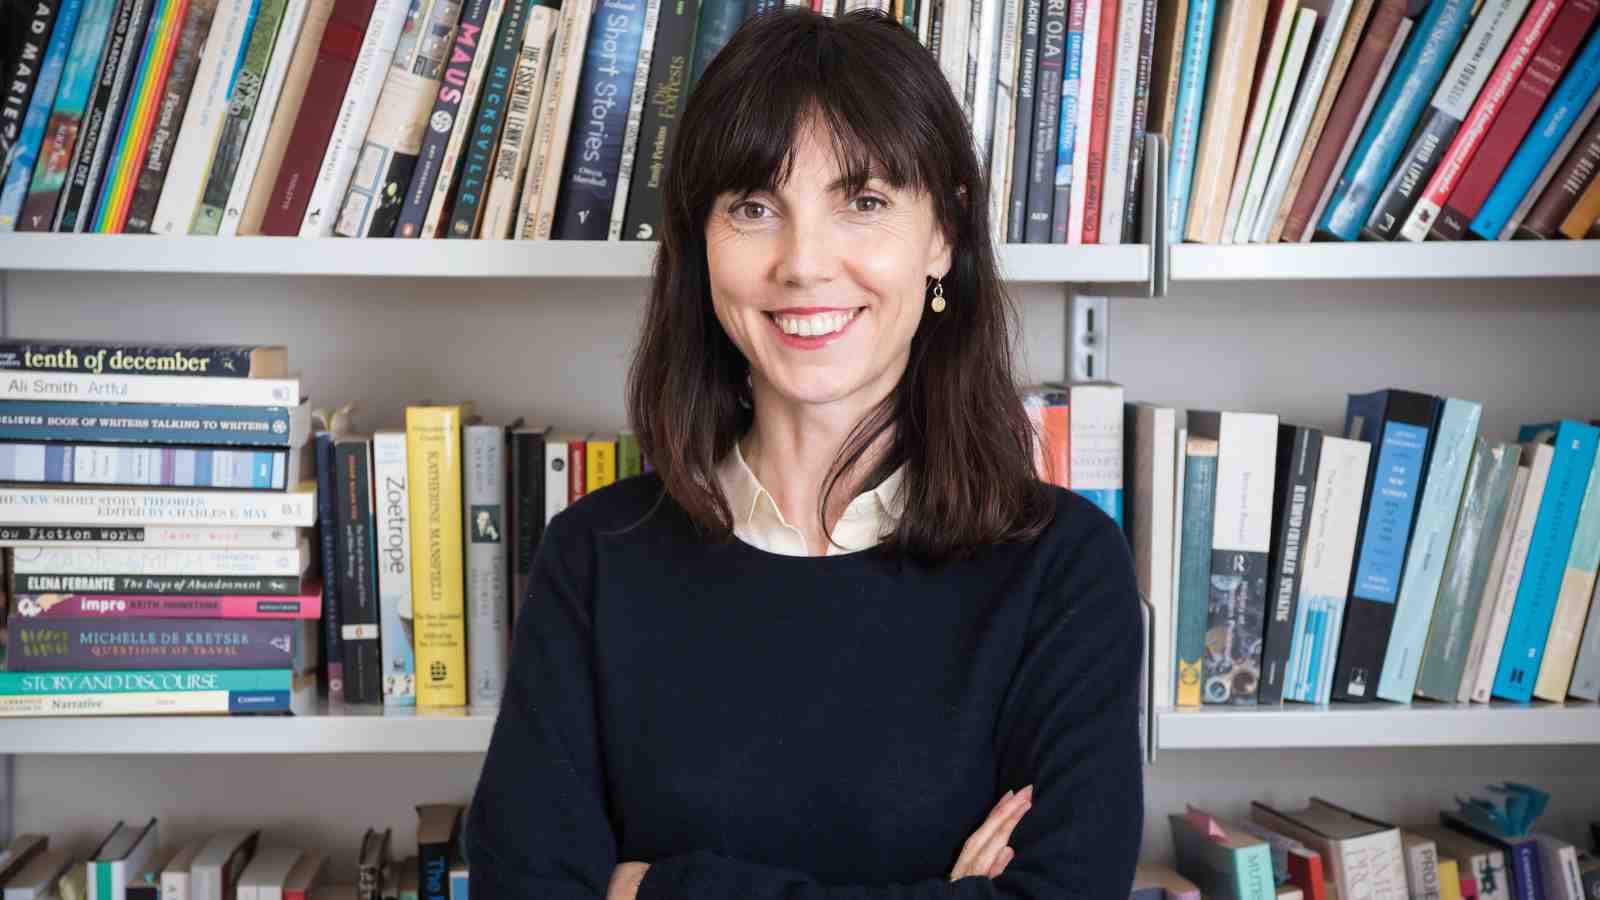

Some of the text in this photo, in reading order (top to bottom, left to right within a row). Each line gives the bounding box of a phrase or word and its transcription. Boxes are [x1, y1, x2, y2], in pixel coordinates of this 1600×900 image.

[520, 45, 540, 66] THE
[597, 14, 629, 77] Short
[1044, 20, 1063, 58] OLA
[102, 34, 125, 87] PARDONS
[440, 21, 480, 105] MAUS
[3, 43, 39, 121] MARIE
[511, 65, 537, 114] ESSENTIAL
[462, 66, 508, 205] HICKSVILLE
[583, 81, 618, 162] Stories
[74, 107, 104, 187] JONATHAN DEE
[1398, 134, 1441, 198] DAVID LIPSKY
[1564, 157, 1595, 197] DESIRE
[24, 350, 78, 369] tenth
[84, 350, 106, 374] of
[110, 352, 210, 372] december
[8, 379, 128, 396] Ali Smith Artful
[47, 416, 78, 427] BOOK
[81, 417, 98, 427] OF
[99, 417, 149, 428] WRITERS
[151, 418, 200, 430] TALKING
[203, 419, 218, 431] TO
[221, 421, 270, 432] WRITERS
[99, 495, 138, 506] STORY
[28, 527, 92, 540] Fiction
[386, 476, 405, 574] Zoetrope
[427, 450, 442, 601] KATHERINE MANSFIELD
[28, 577, 261, 592] ELENA FERRANTE The Days of Abandonment
[81, 598, 127, 612] impro
[80, 632, 155, 645] MICHELLE
[161, 633, 179, 645] DE
[186, 633, 249, 645] KRETSER
[22, 673, 219, 690] STORY AND DISCOURSE
[51, 697, 103, 710] Narrative
